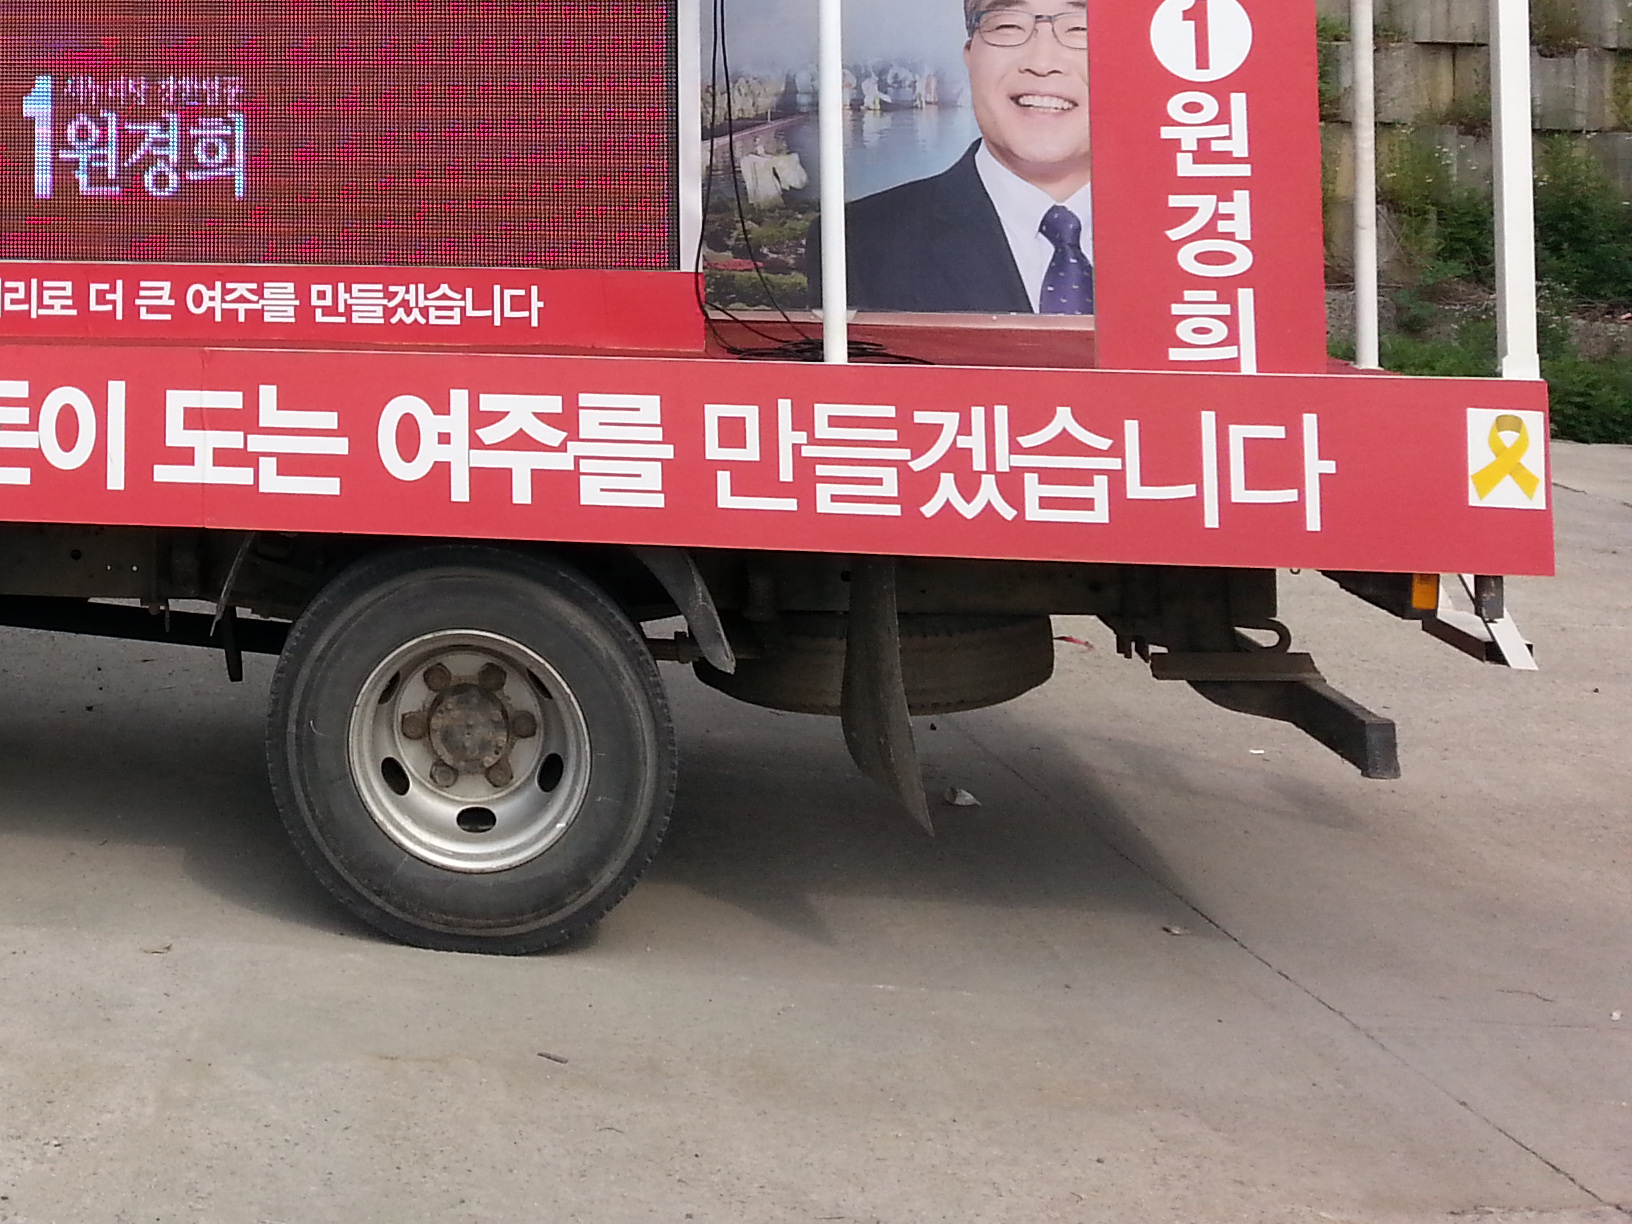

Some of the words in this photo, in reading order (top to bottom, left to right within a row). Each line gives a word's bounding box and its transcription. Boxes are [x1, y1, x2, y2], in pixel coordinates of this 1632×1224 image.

[22, 75, 53, 199] 1
[59, 110, 244, 199] 원경희
[1160, 90, 1257, 374] 원경희
[89, 279, 123, 319] 더
[135, 280, 175, 320] 큰
[186, 280, 299, 323] 여주를
[310, 282, 544, 327] 만들겠습니다
[153, 384, 349, 496] 도는
[377, 389, 674, 508] 여주를
[704, 397, 1337, 531] 만들겠습니다
